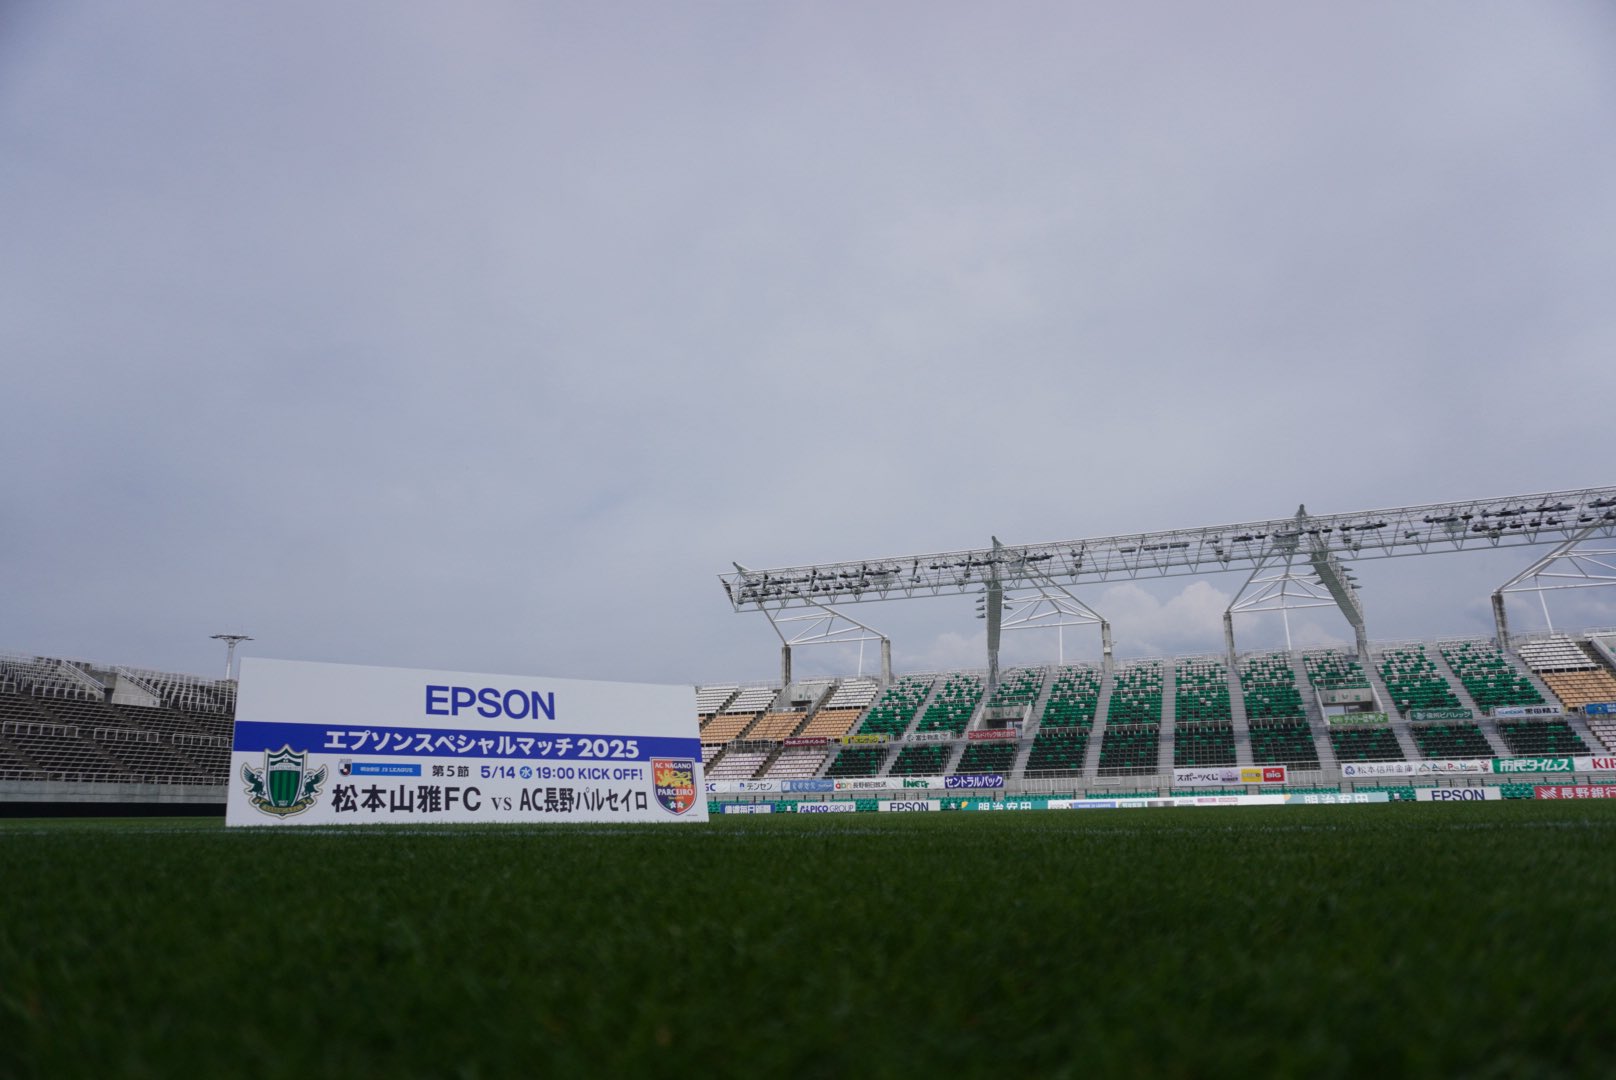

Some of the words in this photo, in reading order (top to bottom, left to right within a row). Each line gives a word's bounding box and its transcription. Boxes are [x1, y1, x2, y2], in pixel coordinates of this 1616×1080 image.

[425, 685, 556, 721] EPSON
[323, 729, 573, 757] エプソンスペシャルマッチ
[577, 738, 640, 759] 2025
[432, 764, 470, 778] 第5節
[1356, 764, 1413, 774] 松本信用金庫
[1499, 759, 1570, 772] 市民タイムス
[480, 765, 515, 780] 5/14
[536, 766, 574, 780] 19:00
[578, 767, 610, 780] KICK
[613, 768, 643, 781] OFF!
[1176, 773, 1219, 782] スポーツくじ
[945, 775, 1003, 788] セントラルパック
[331, 783, 482, 814] 松本山雅FC
[520, 786, 648, 813] AC長野パルセイロ
[657, 788, 694, 796] PARCEIRO
[1431, 789, 1485, 801] EPSON
[829, 804, 854, 812] GROUP
[889, 802, 929, 812] EPSON
